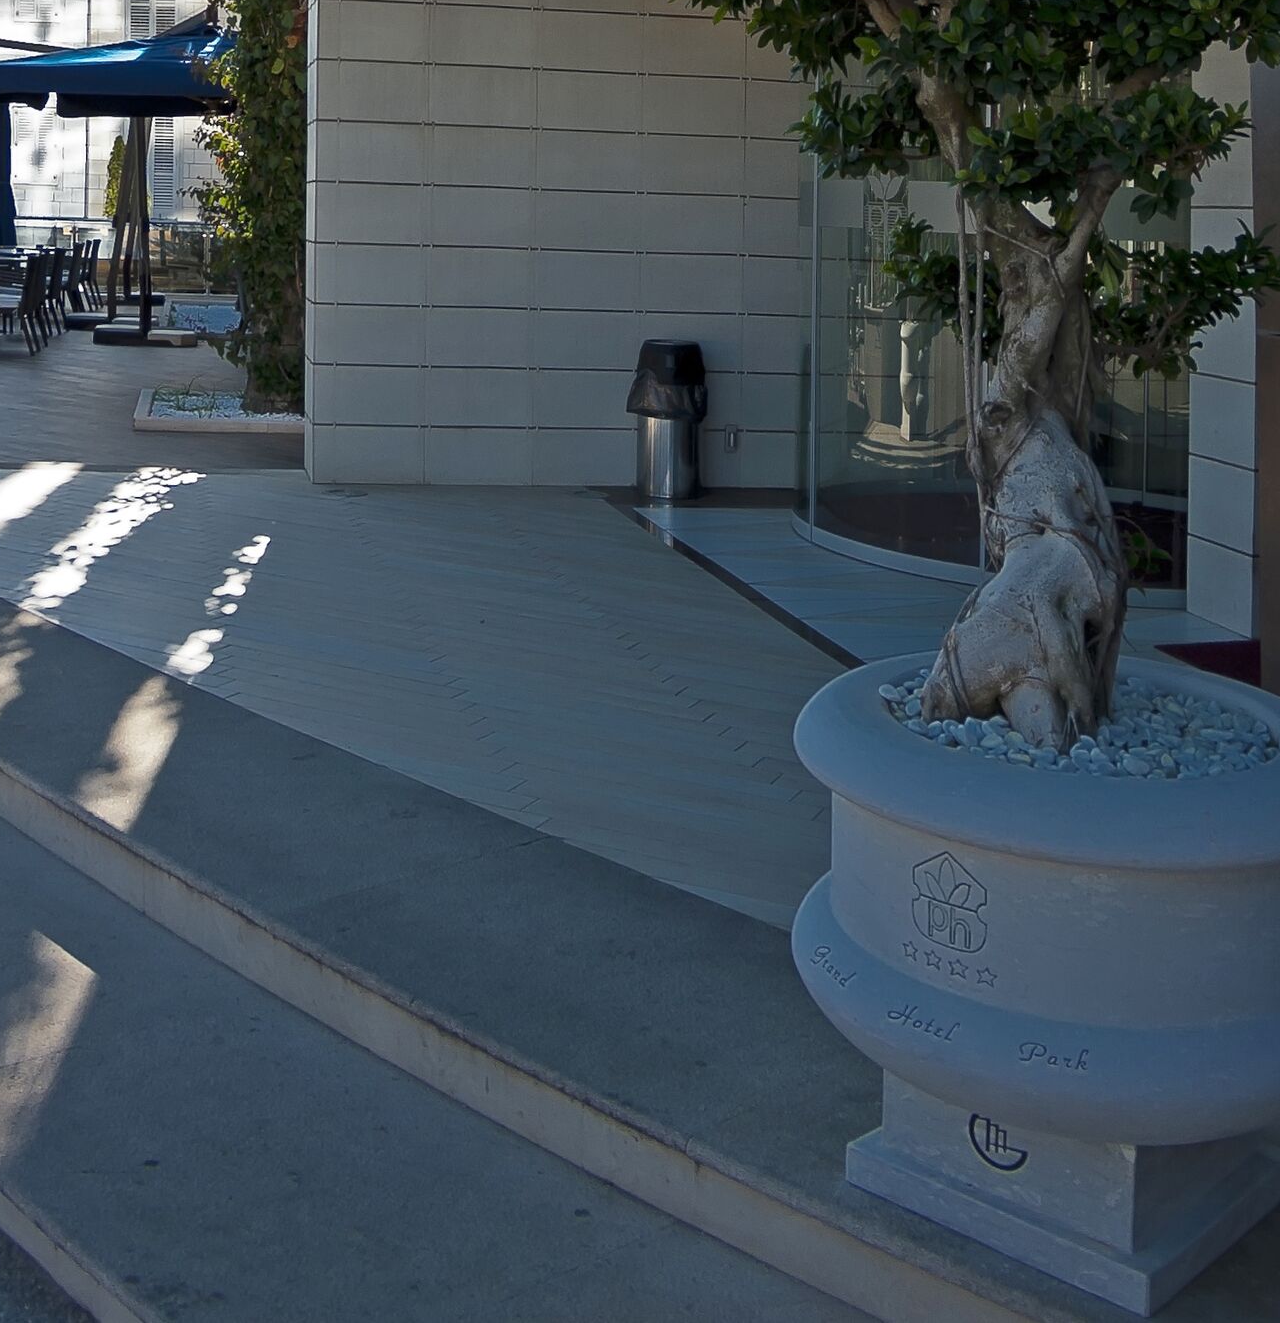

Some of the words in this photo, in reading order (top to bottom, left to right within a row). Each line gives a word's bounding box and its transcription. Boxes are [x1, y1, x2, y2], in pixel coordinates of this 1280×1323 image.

[810, 945, 857, 988] Grand
[886, 1004, 961, 1042] Hotel
[1017, 1041, 1089, 1071] Park
